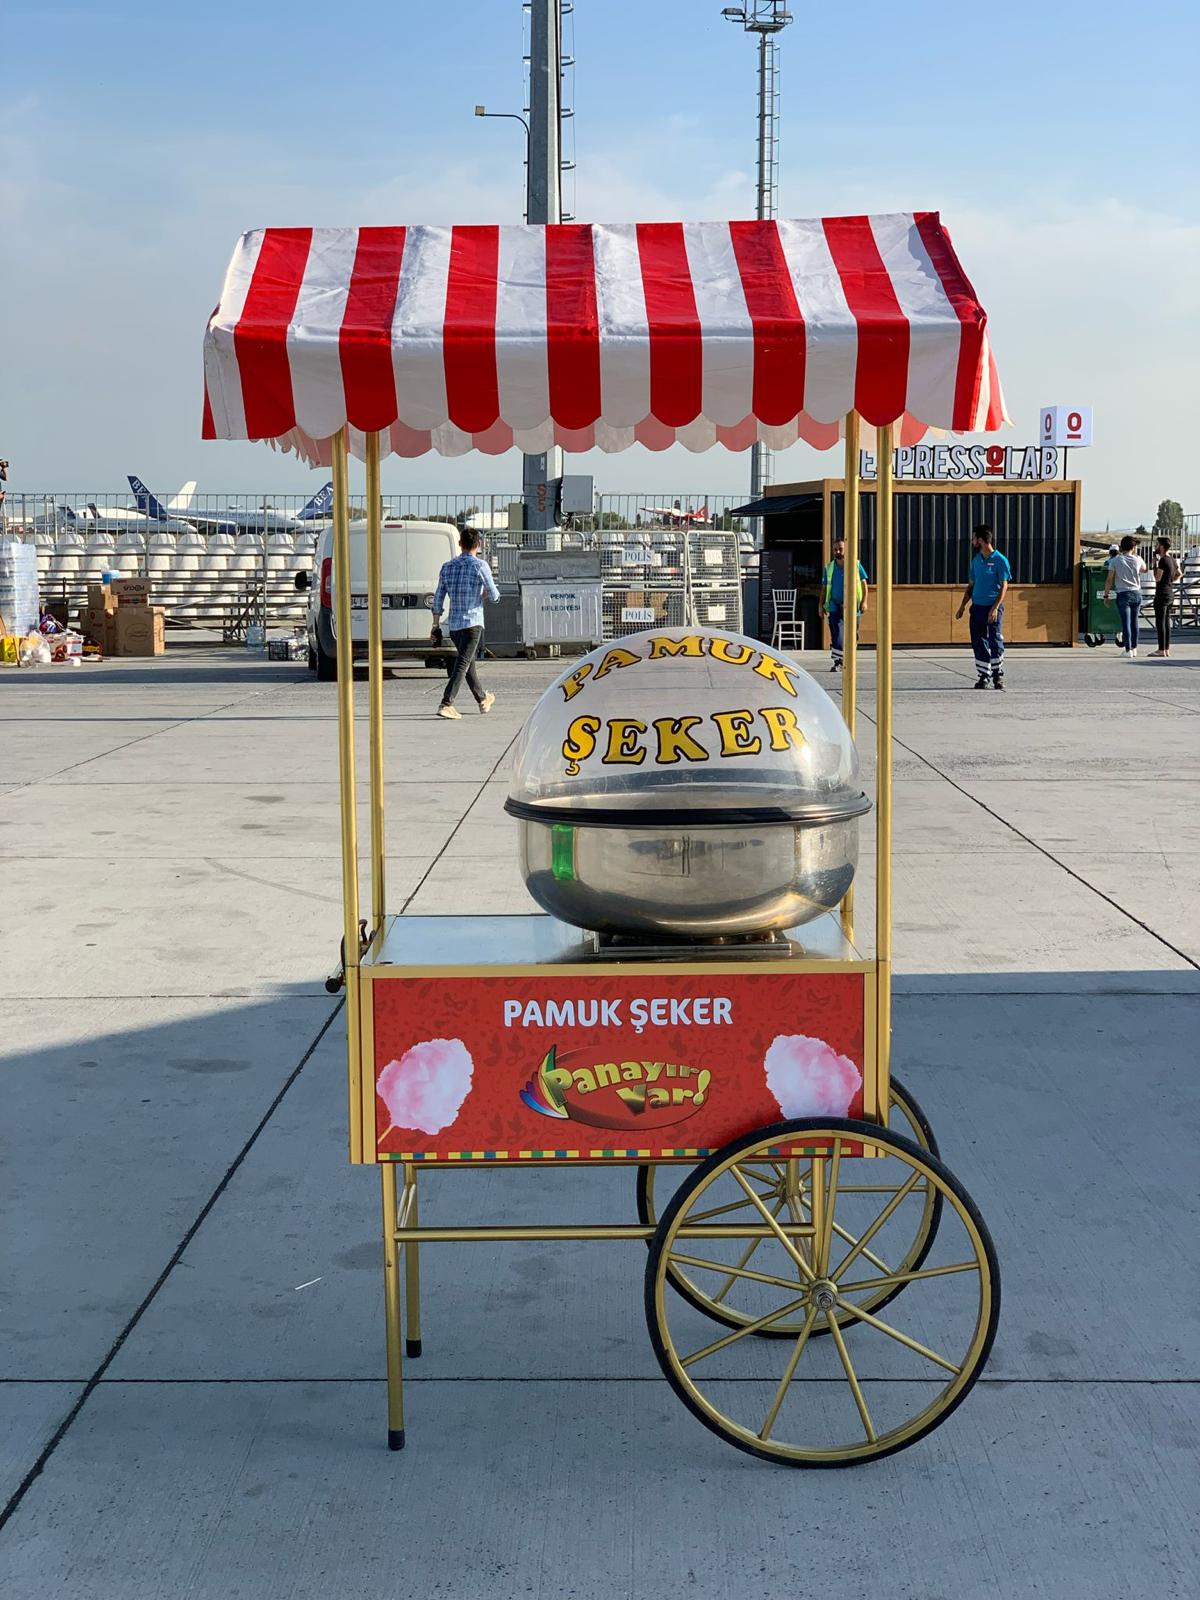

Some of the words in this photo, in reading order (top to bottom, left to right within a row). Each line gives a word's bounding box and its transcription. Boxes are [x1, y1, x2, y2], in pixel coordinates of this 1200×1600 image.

[859, 445, 1058, 480] EPRESSOLAB
[624, 550, 652, 562] POLİS
[624, 608, 653, 621] POLİS
[558, 635, 800, 702] PAMUK
[562, 707, 808, 776] ŞEKER
[503, 999, 623, 1028] PAMUK
[629, 997, 734, 1034] ŞEKER
[542, 1061, 700, 1108] Panayır
[615, 1068, 712, 1116] Var!
